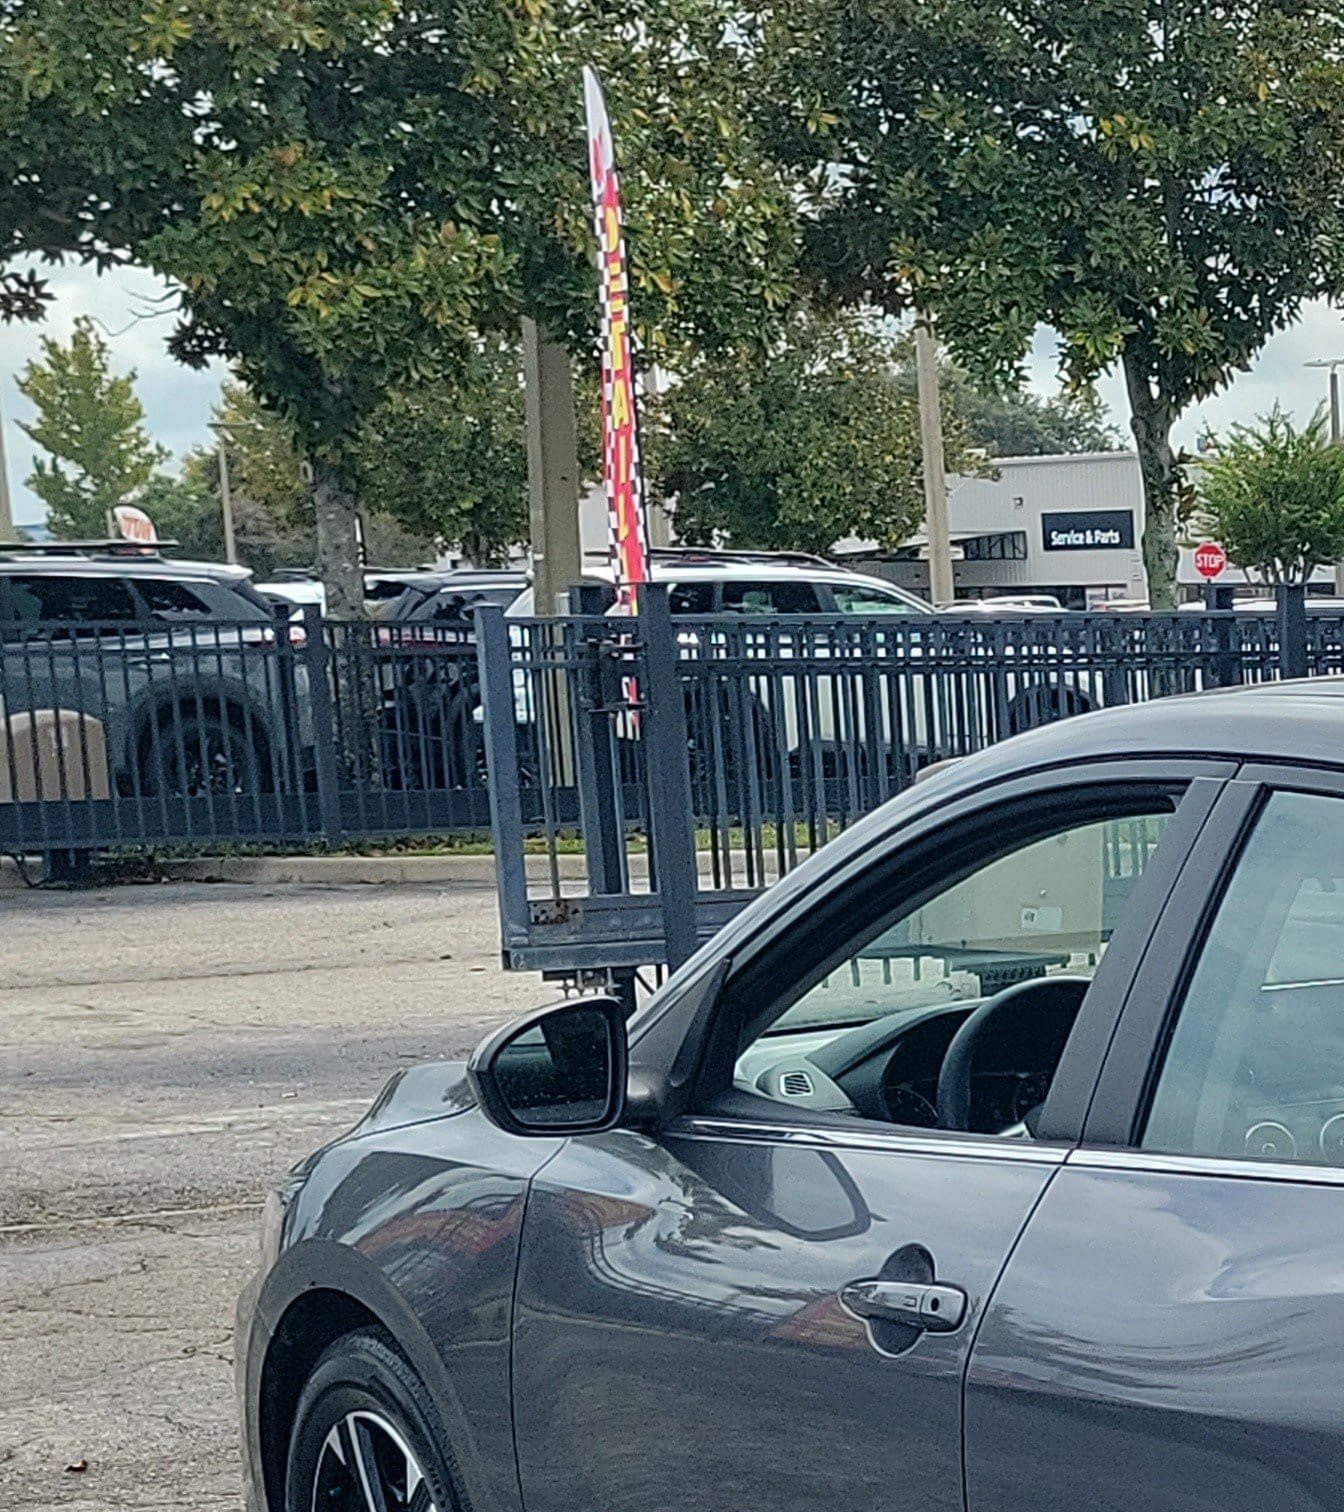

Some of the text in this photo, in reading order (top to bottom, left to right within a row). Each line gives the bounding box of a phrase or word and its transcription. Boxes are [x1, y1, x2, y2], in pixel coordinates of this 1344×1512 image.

[1051, 528, 1121, 546] Service & Parts
[1196, 553, 1224, 568] STOP
